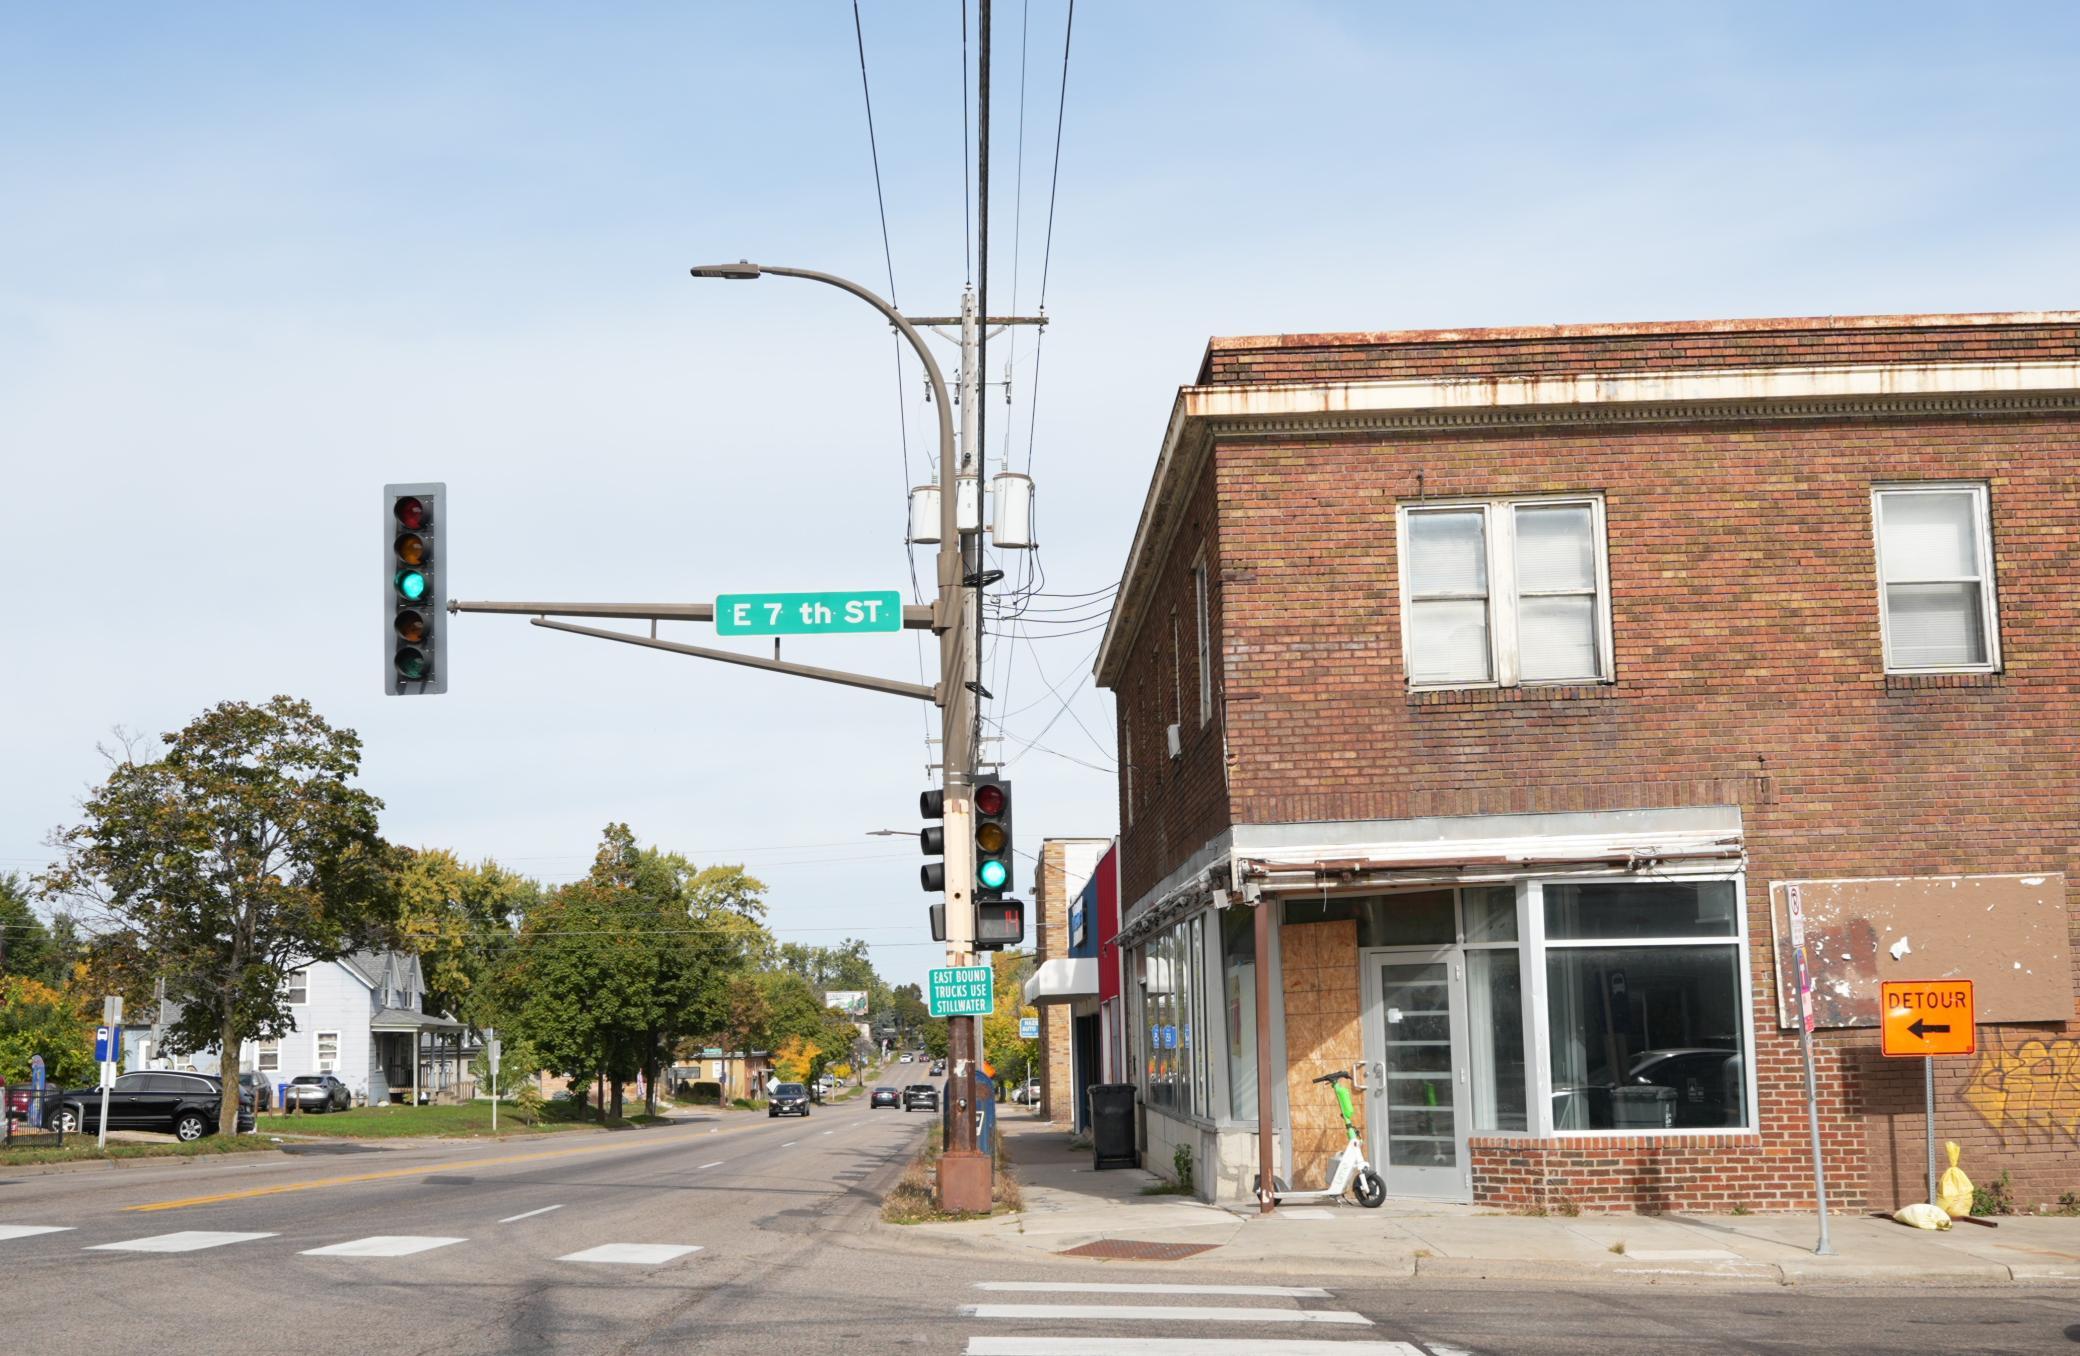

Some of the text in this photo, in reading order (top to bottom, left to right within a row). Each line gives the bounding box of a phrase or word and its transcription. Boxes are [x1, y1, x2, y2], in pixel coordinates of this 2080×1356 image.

[733, 600, 883, 626] E 7 th ST
[934, 969, 986, 984] EAST BOUND
[935, 984, 987, 998] TRUCKS USE
[937, 999, 986, 1013] STILLWATER
[1889, 991, 1966, 1009] DETOUR
